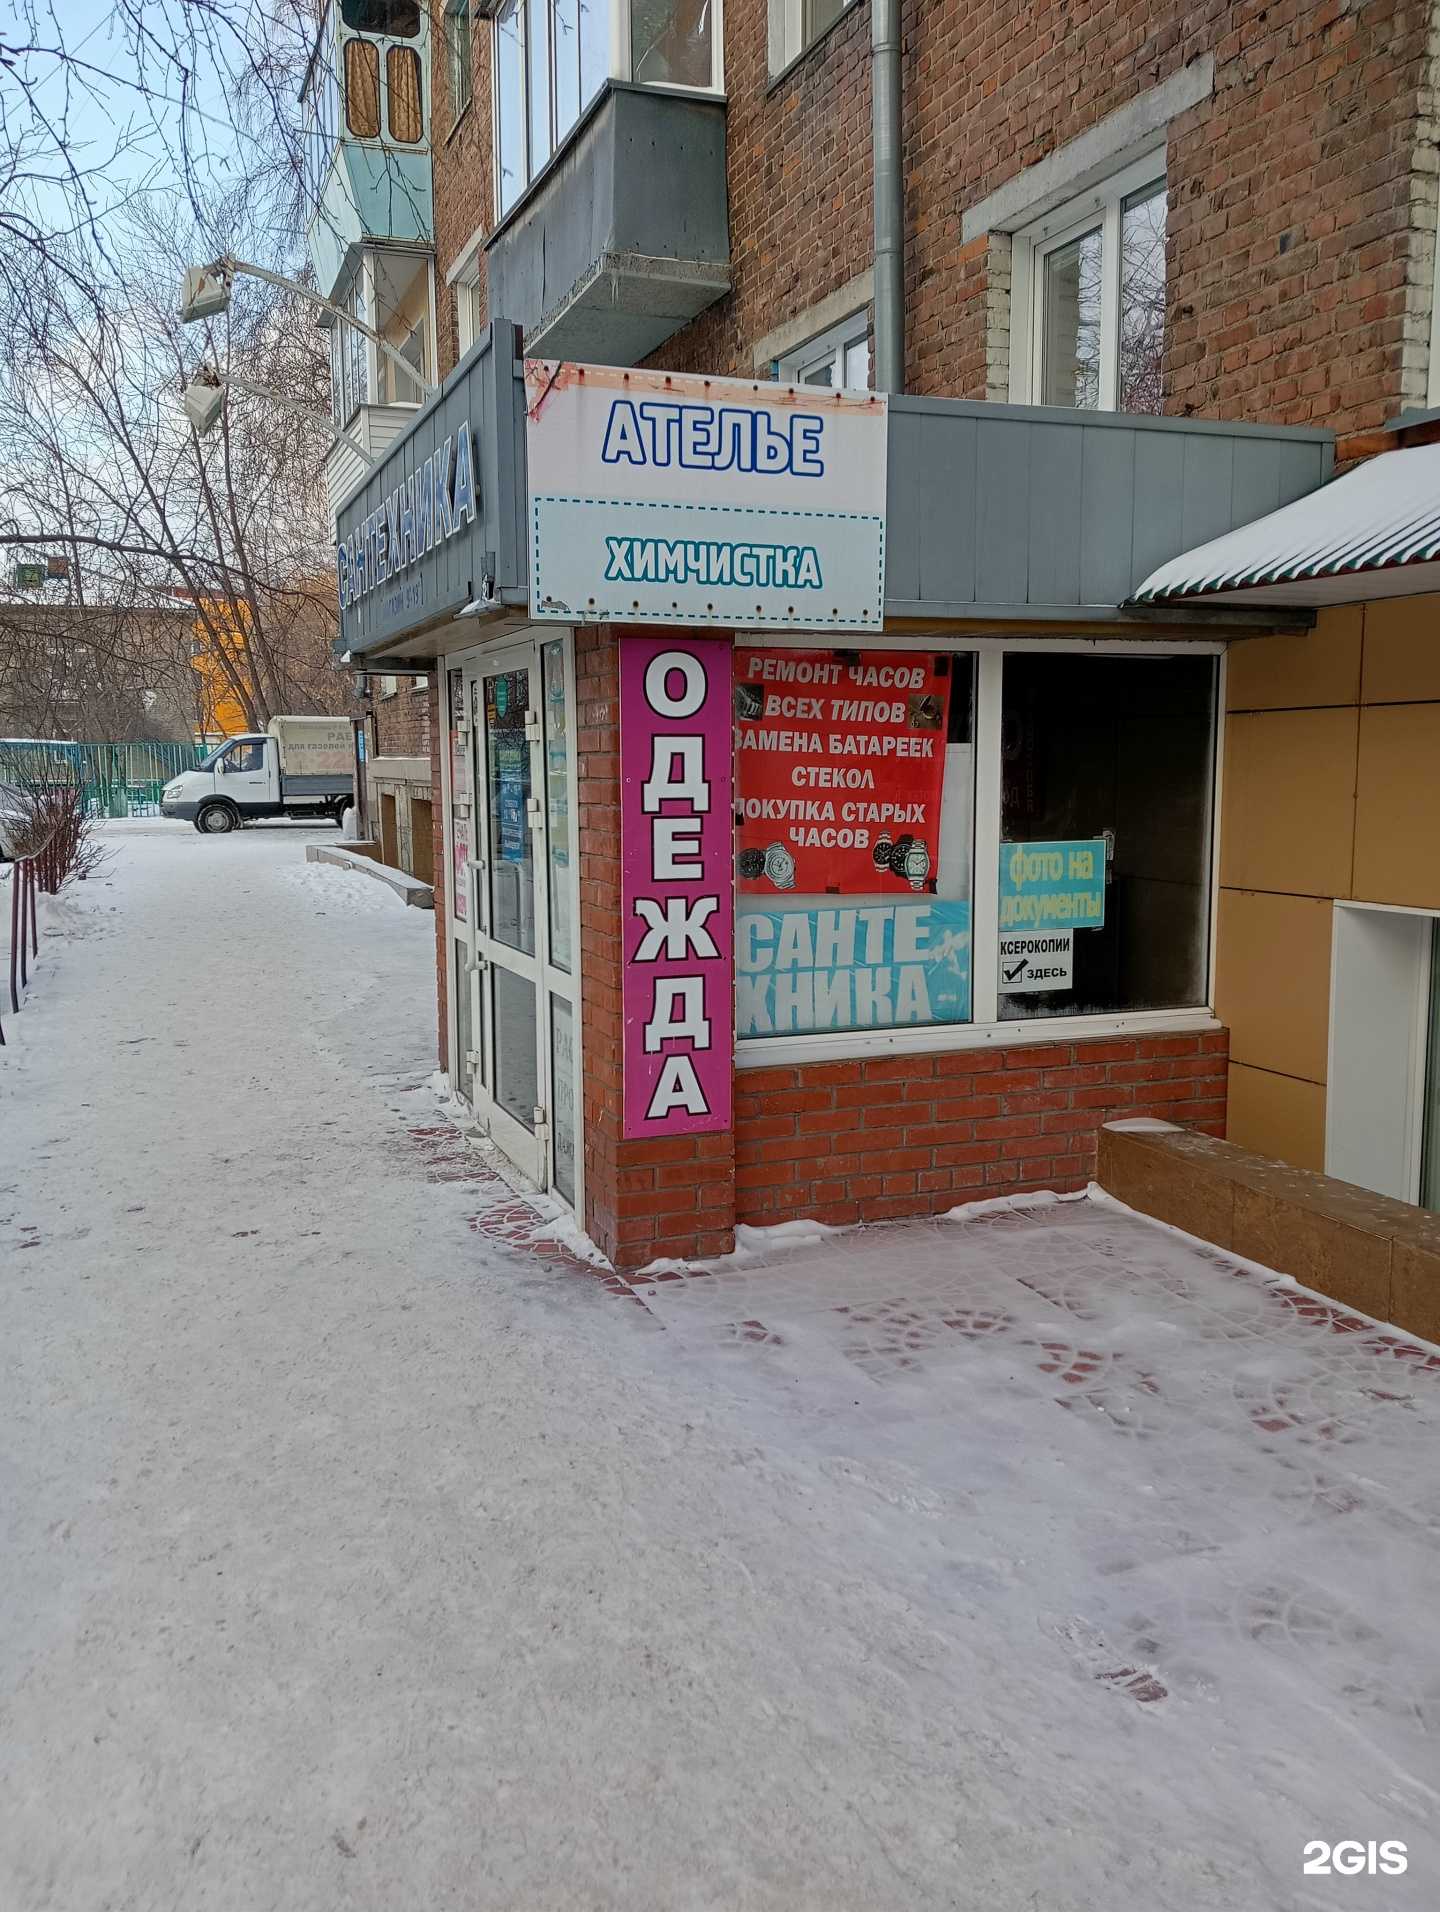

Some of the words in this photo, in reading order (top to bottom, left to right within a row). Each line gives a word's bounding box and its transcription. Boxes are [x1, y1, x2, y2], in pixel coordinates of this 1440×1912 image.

[602, 400, 824, 478] АТЕЛЬЕ
[337, 420, 477, 611] САНТЕХНИКА
[604, 537, 823, 589] ХИМЧИСТКА
[747, 657, 843, 685] РЕМОНТ
[848, 665, 926, 689] ЧАСОВ
[764, 694, 824, 720] ВСЕХ
[831, 699, 906, 723] ТИПОВ
[828, 734, 934, 758] БАТАРЕЕК
[791, 766, 875, 789] СТЕКОЛ
[841, 802, 926, 823] СТАРЫХ
[789, 827, 870, 849] ЧАСОВ
[1068, 849, 1094, 880] на
[631, 648, 722, 1122] ОДЕЖДА
[737, 904, 932, 973] САНТЕ
[1000, 938, 1070, 956] КСЕРОКОПИИ
[1027, 967, 1067, 980] ЗДЕСЬ
[737, 965, 933, 1033] ХНИКА
